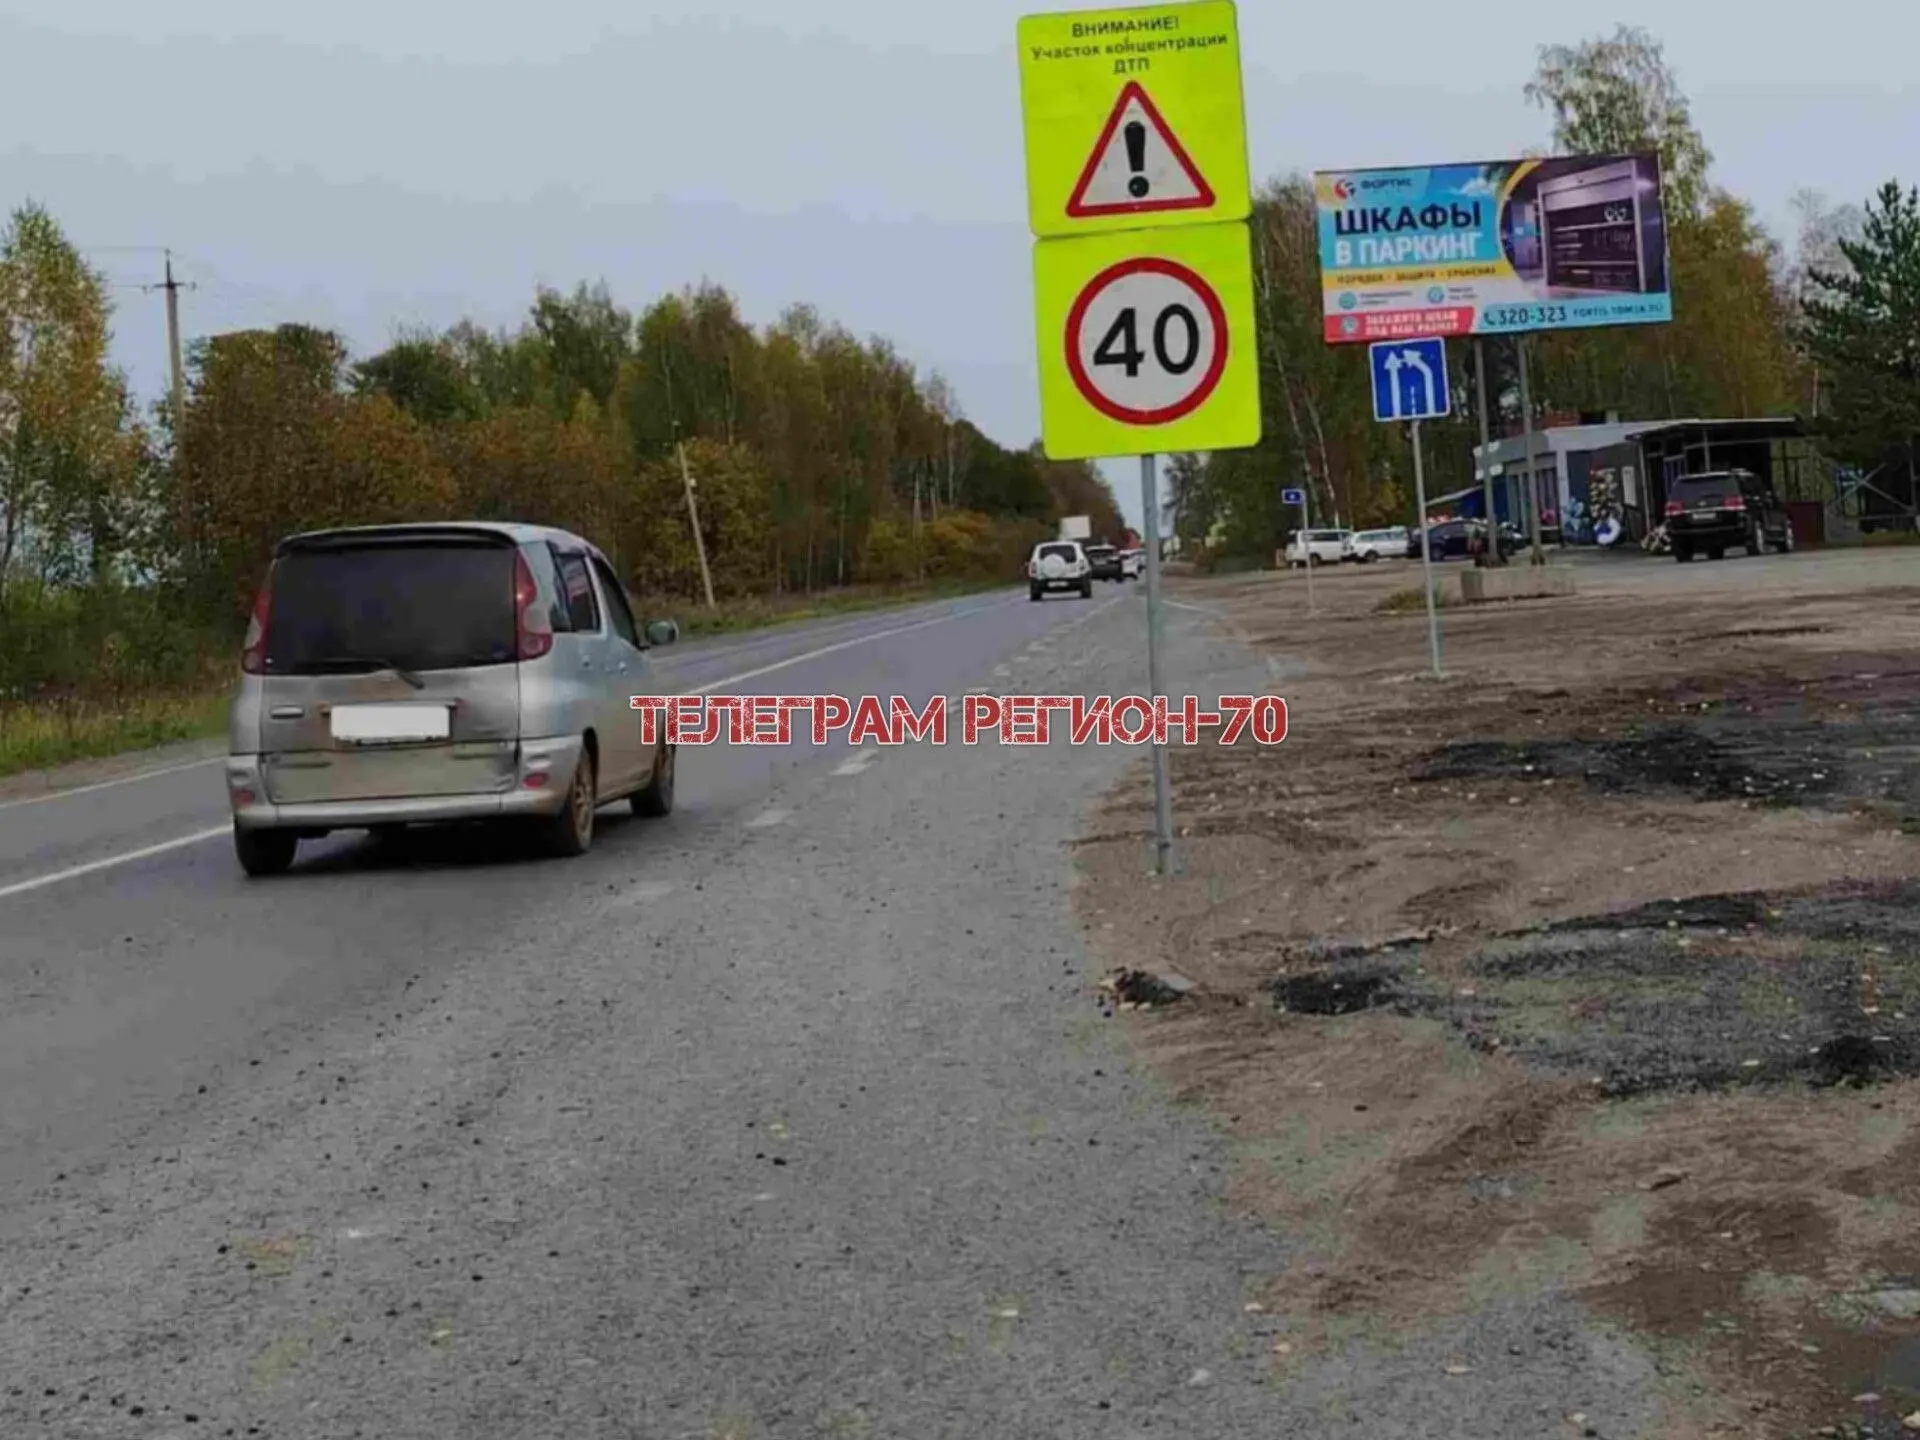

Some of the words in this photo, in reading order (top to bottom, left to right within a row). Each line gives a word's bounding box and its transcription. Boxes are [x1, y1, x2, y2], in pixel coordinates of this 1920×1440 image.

[1072, 16, 1180, 37] ВНИМАНИЕ!
[1031, 46, 1100, 60] Участок
[1105, 34, 1227, 55] концентрации
[1114, 57, 1150, 74] ДТП
[1335, 201, 1481, 235] ШКАФЫ
[1335, 240, 1352, 265] В
[1359, 232, 1483, 265] ПАРКИНГ
[1499, 306, 1567, 326] 320-323
[1093, 304, 1199, 377] 40
